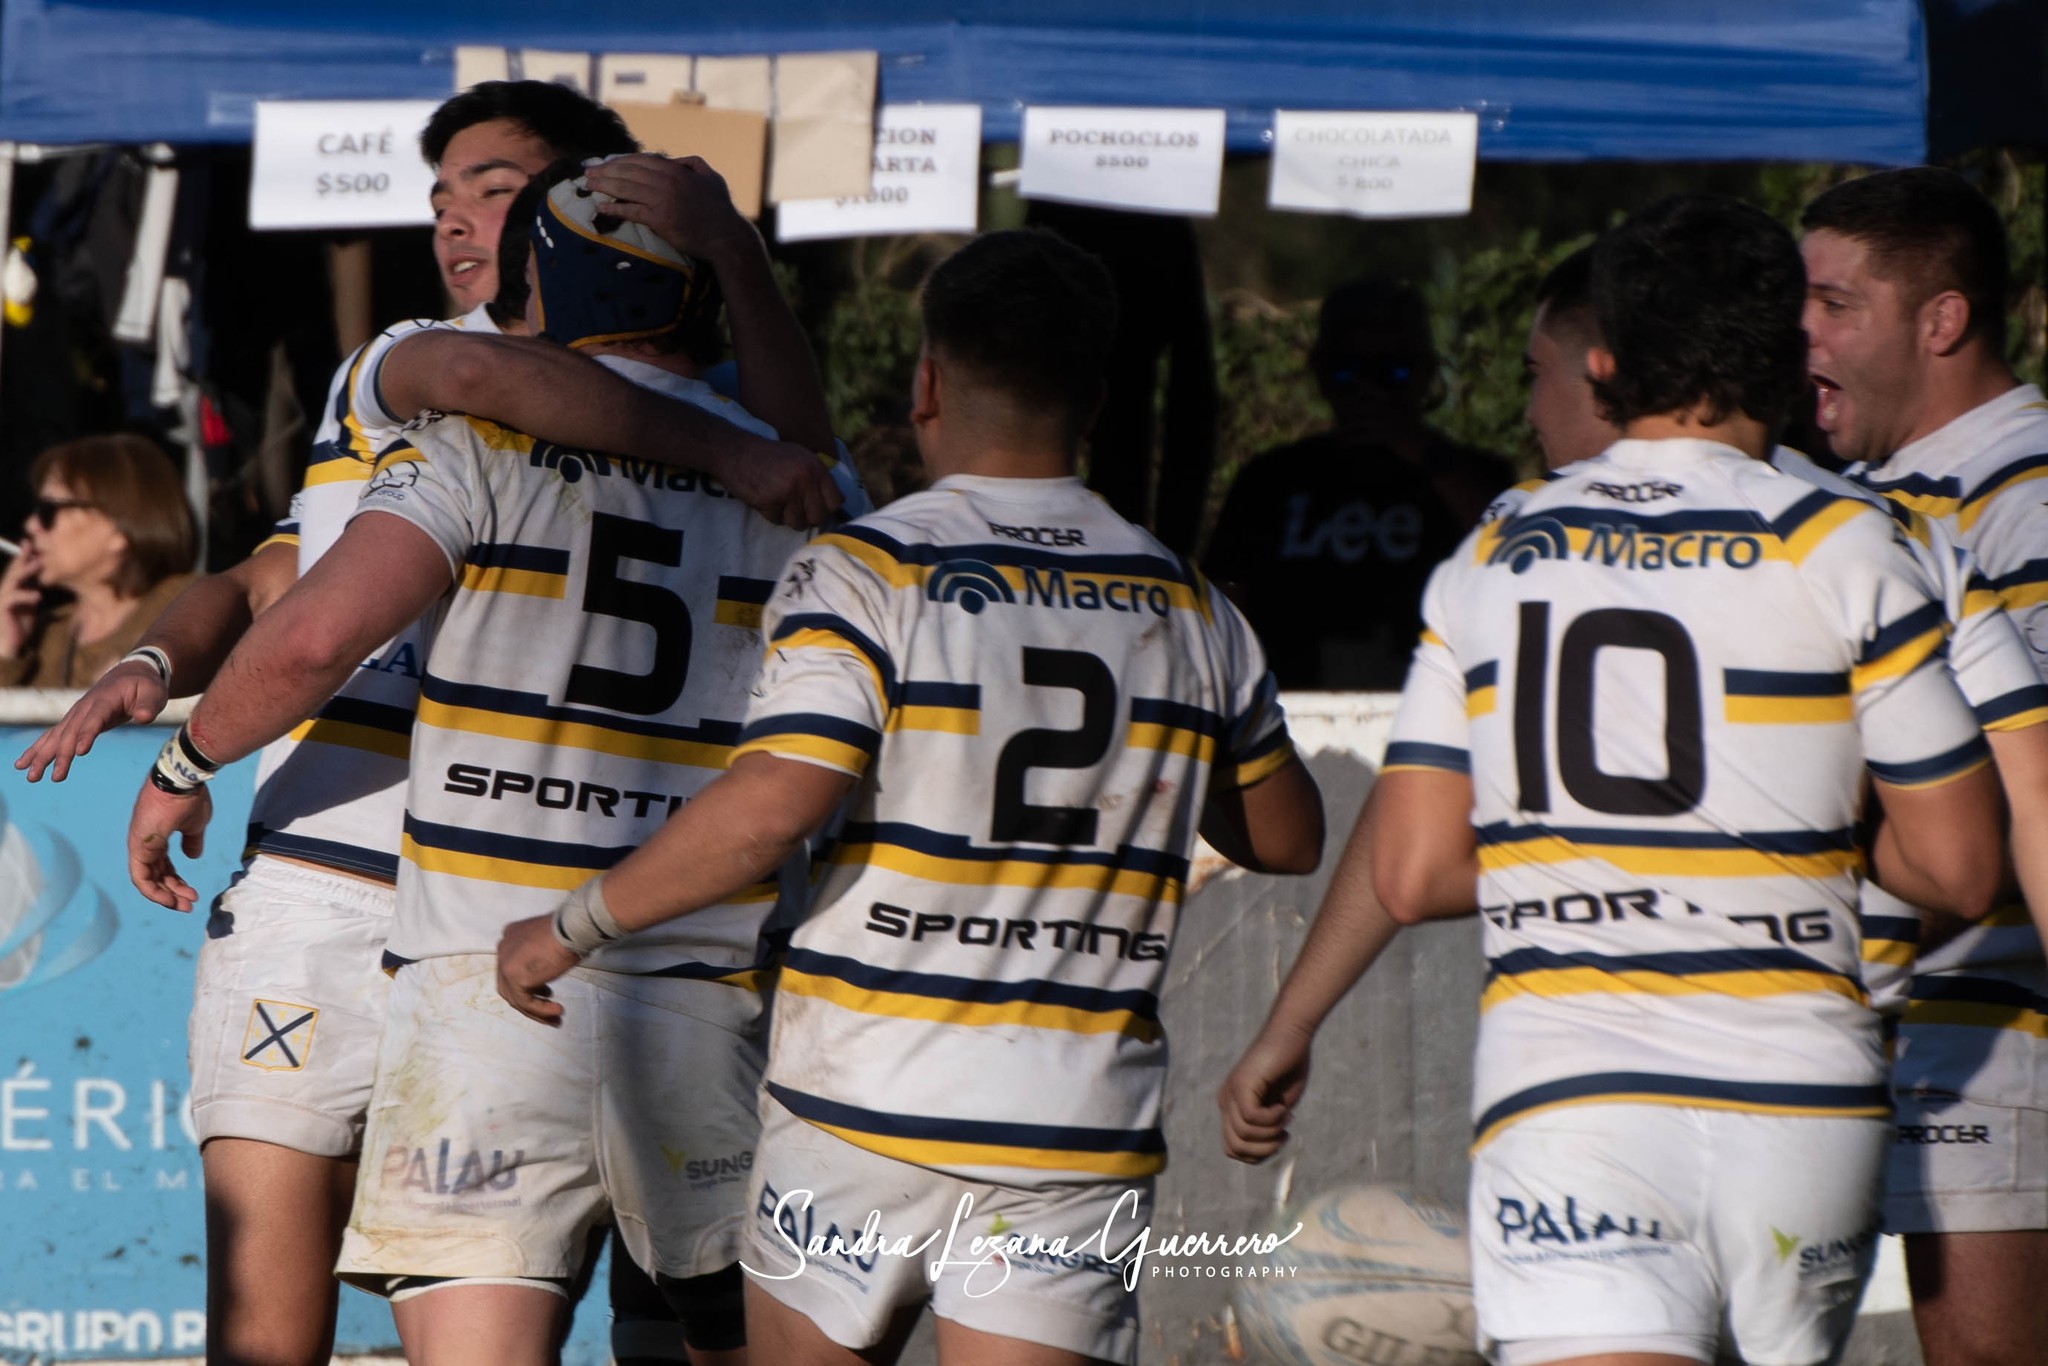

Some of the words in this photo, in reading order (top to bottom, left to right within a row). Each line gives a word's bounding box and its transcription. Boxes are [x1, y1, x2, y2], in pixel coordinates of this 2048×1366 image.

[317, 131, 393, 156] CAFÉ
[1049, 128, 1199, 148] POCHOCLOS
[1294, 126, 1453, 146] CHOCOLATADA
[1338, 154, 1401, 170] CHICA
[316, 172, 390, 198] $500
[1280, 493, 1423, 560] Lee
[1582, 523, 1762, 571] Macro
[563, 510, 694, 716] 5
[1020, 565, 1171, 618] Macro
[1513, 600, 1707, 817] 10
[990, 645, 1118, 846] 2
[444, 762, 692, 819] SPORTI
[865, 902, 1167, 962] SPORTING
[72, 1168, 121, 1192] EL
[380, 1138, 525, 1195] PALAU
